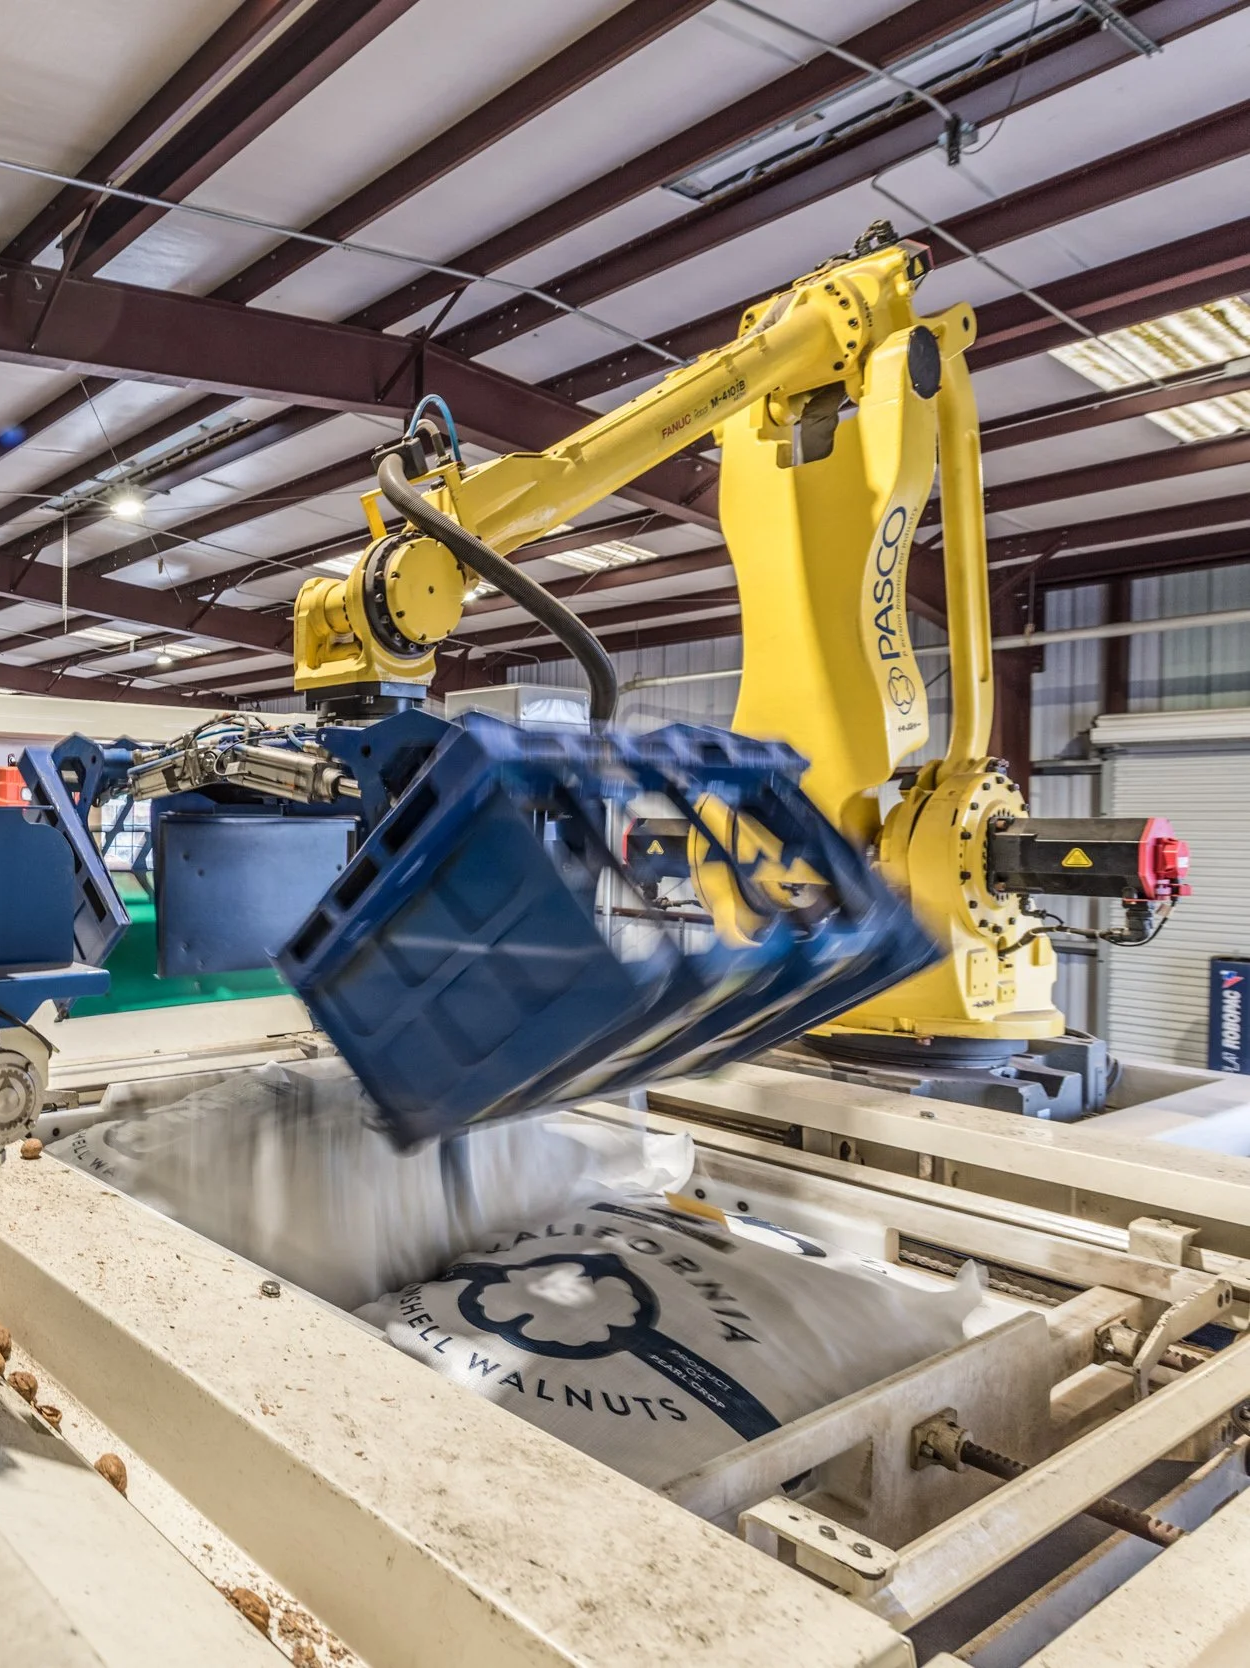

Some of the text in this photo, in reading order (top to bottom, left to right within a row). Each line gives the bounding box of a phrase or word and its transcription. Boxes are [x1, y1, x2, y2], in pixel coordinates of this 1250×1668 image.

[662, 413, 692, 439] FANUC
[873, 506, 907, 660] PASCO
[468, 1352, 688, 1422] WALNUTS
[649, 1354, 726, 1408] PEARL CROP
[670, 1349, 732, 1391] PRODUCT
[686, 1366, 705, 1382] OF
